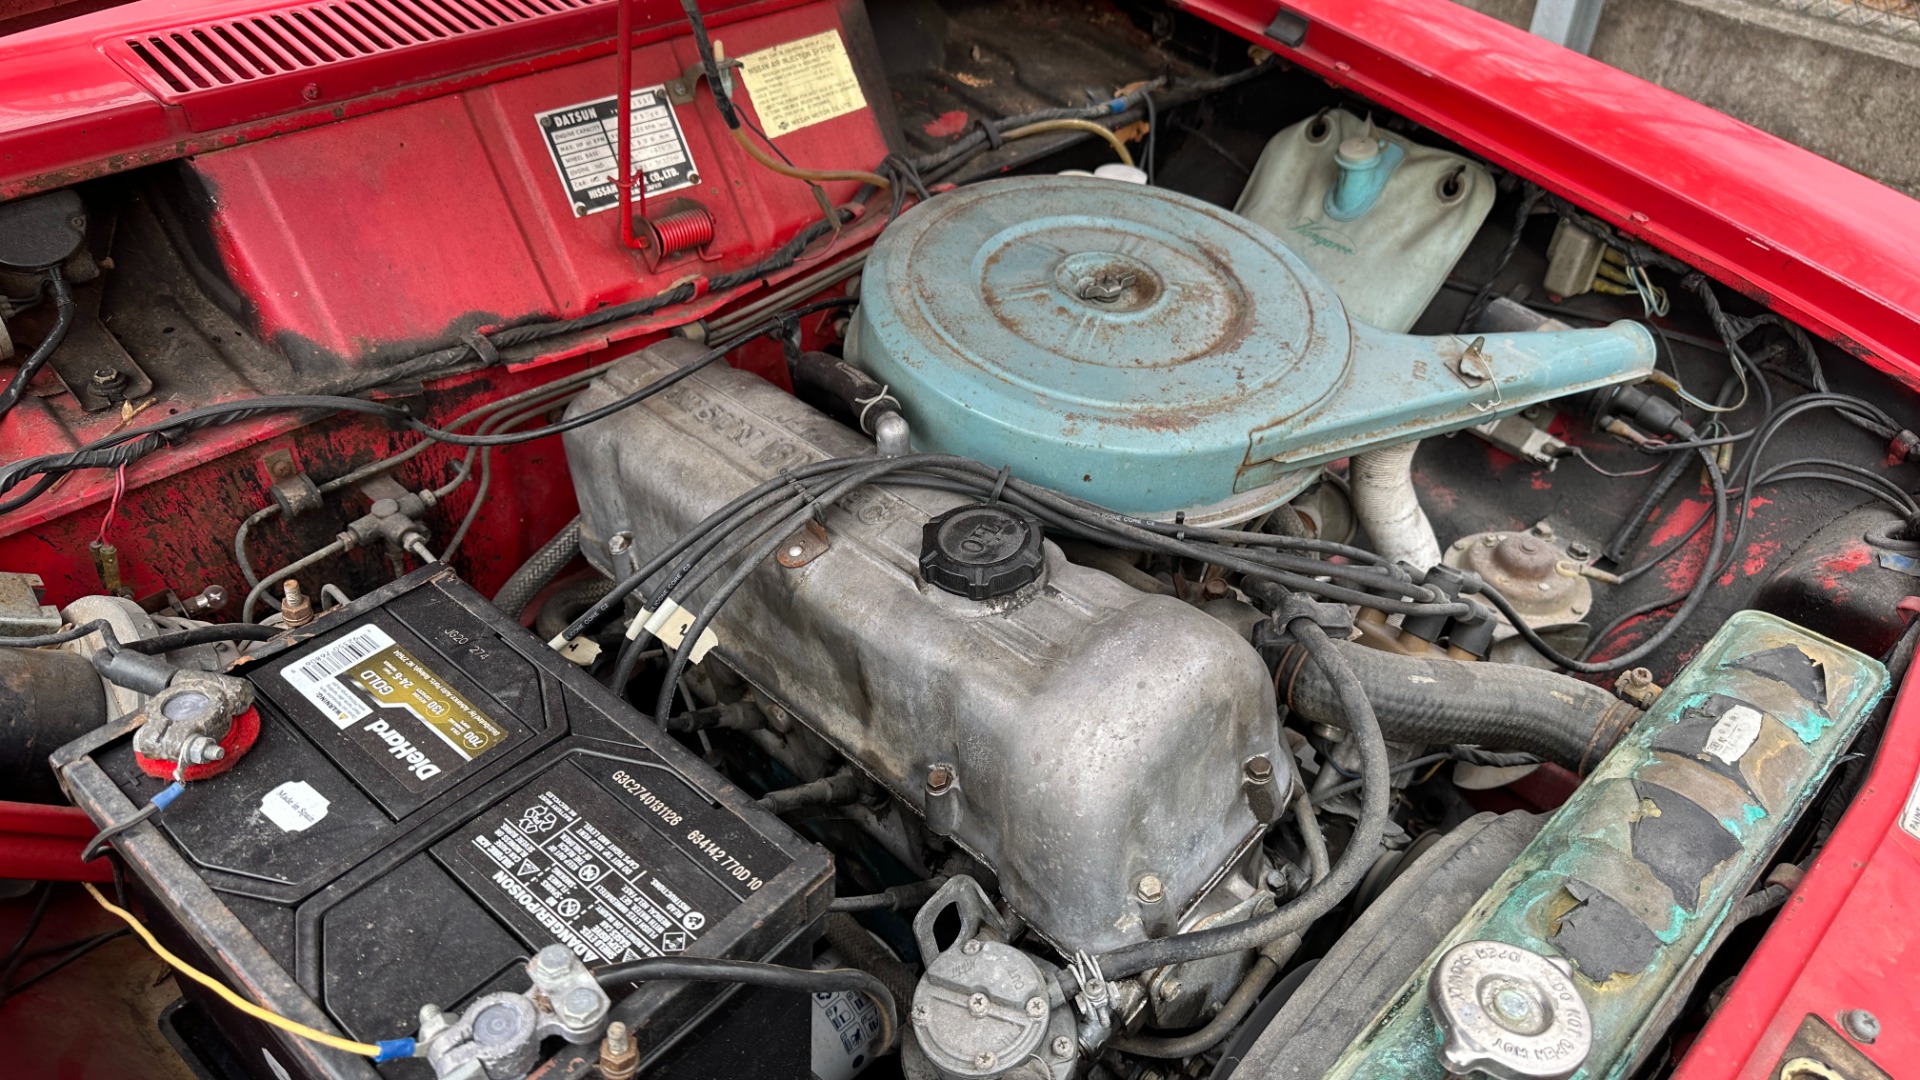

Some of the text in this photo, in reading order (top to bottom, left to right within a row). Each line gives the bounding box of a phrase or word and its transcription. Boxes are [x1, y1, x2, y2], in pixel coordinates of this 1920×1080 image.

[552, 107, 598, 127] DATSUN
[554, 130, 575, 140] ENGINE
[575, 124, 600, 135] CAPACITY
[587, 183, 618, 199] NISSAN
[359, 667, 395, 697] GOLD
[425, 699, 445, 715] 130
[462, 730, 484, 747] 700
[364, 717, 442, 781] DieHard
[276, 789, 315, 822] Made in Spain
[574, 826, 594, 841] VENT
[611, 768, 763, 891] G3C2740131126 634142 770D 10
[588, 837, 606, 852] KEEP
[596, 833, 612, 847] AND
[607, 842, 627, 858] TIGHT
[609, 855, 626, 868] NOT
[620, 864, 634, 875] DO
[621, 854, 640, 870] CAPS
[489, 869, 591, 955] DANGER/POISON
[665, 902, 684, 918] READ
[1475, 948, 1521, 963] OPEN
[1552, 982, 1574, 1001] DO
[1567, 1008, 1583, 1037] NOT
